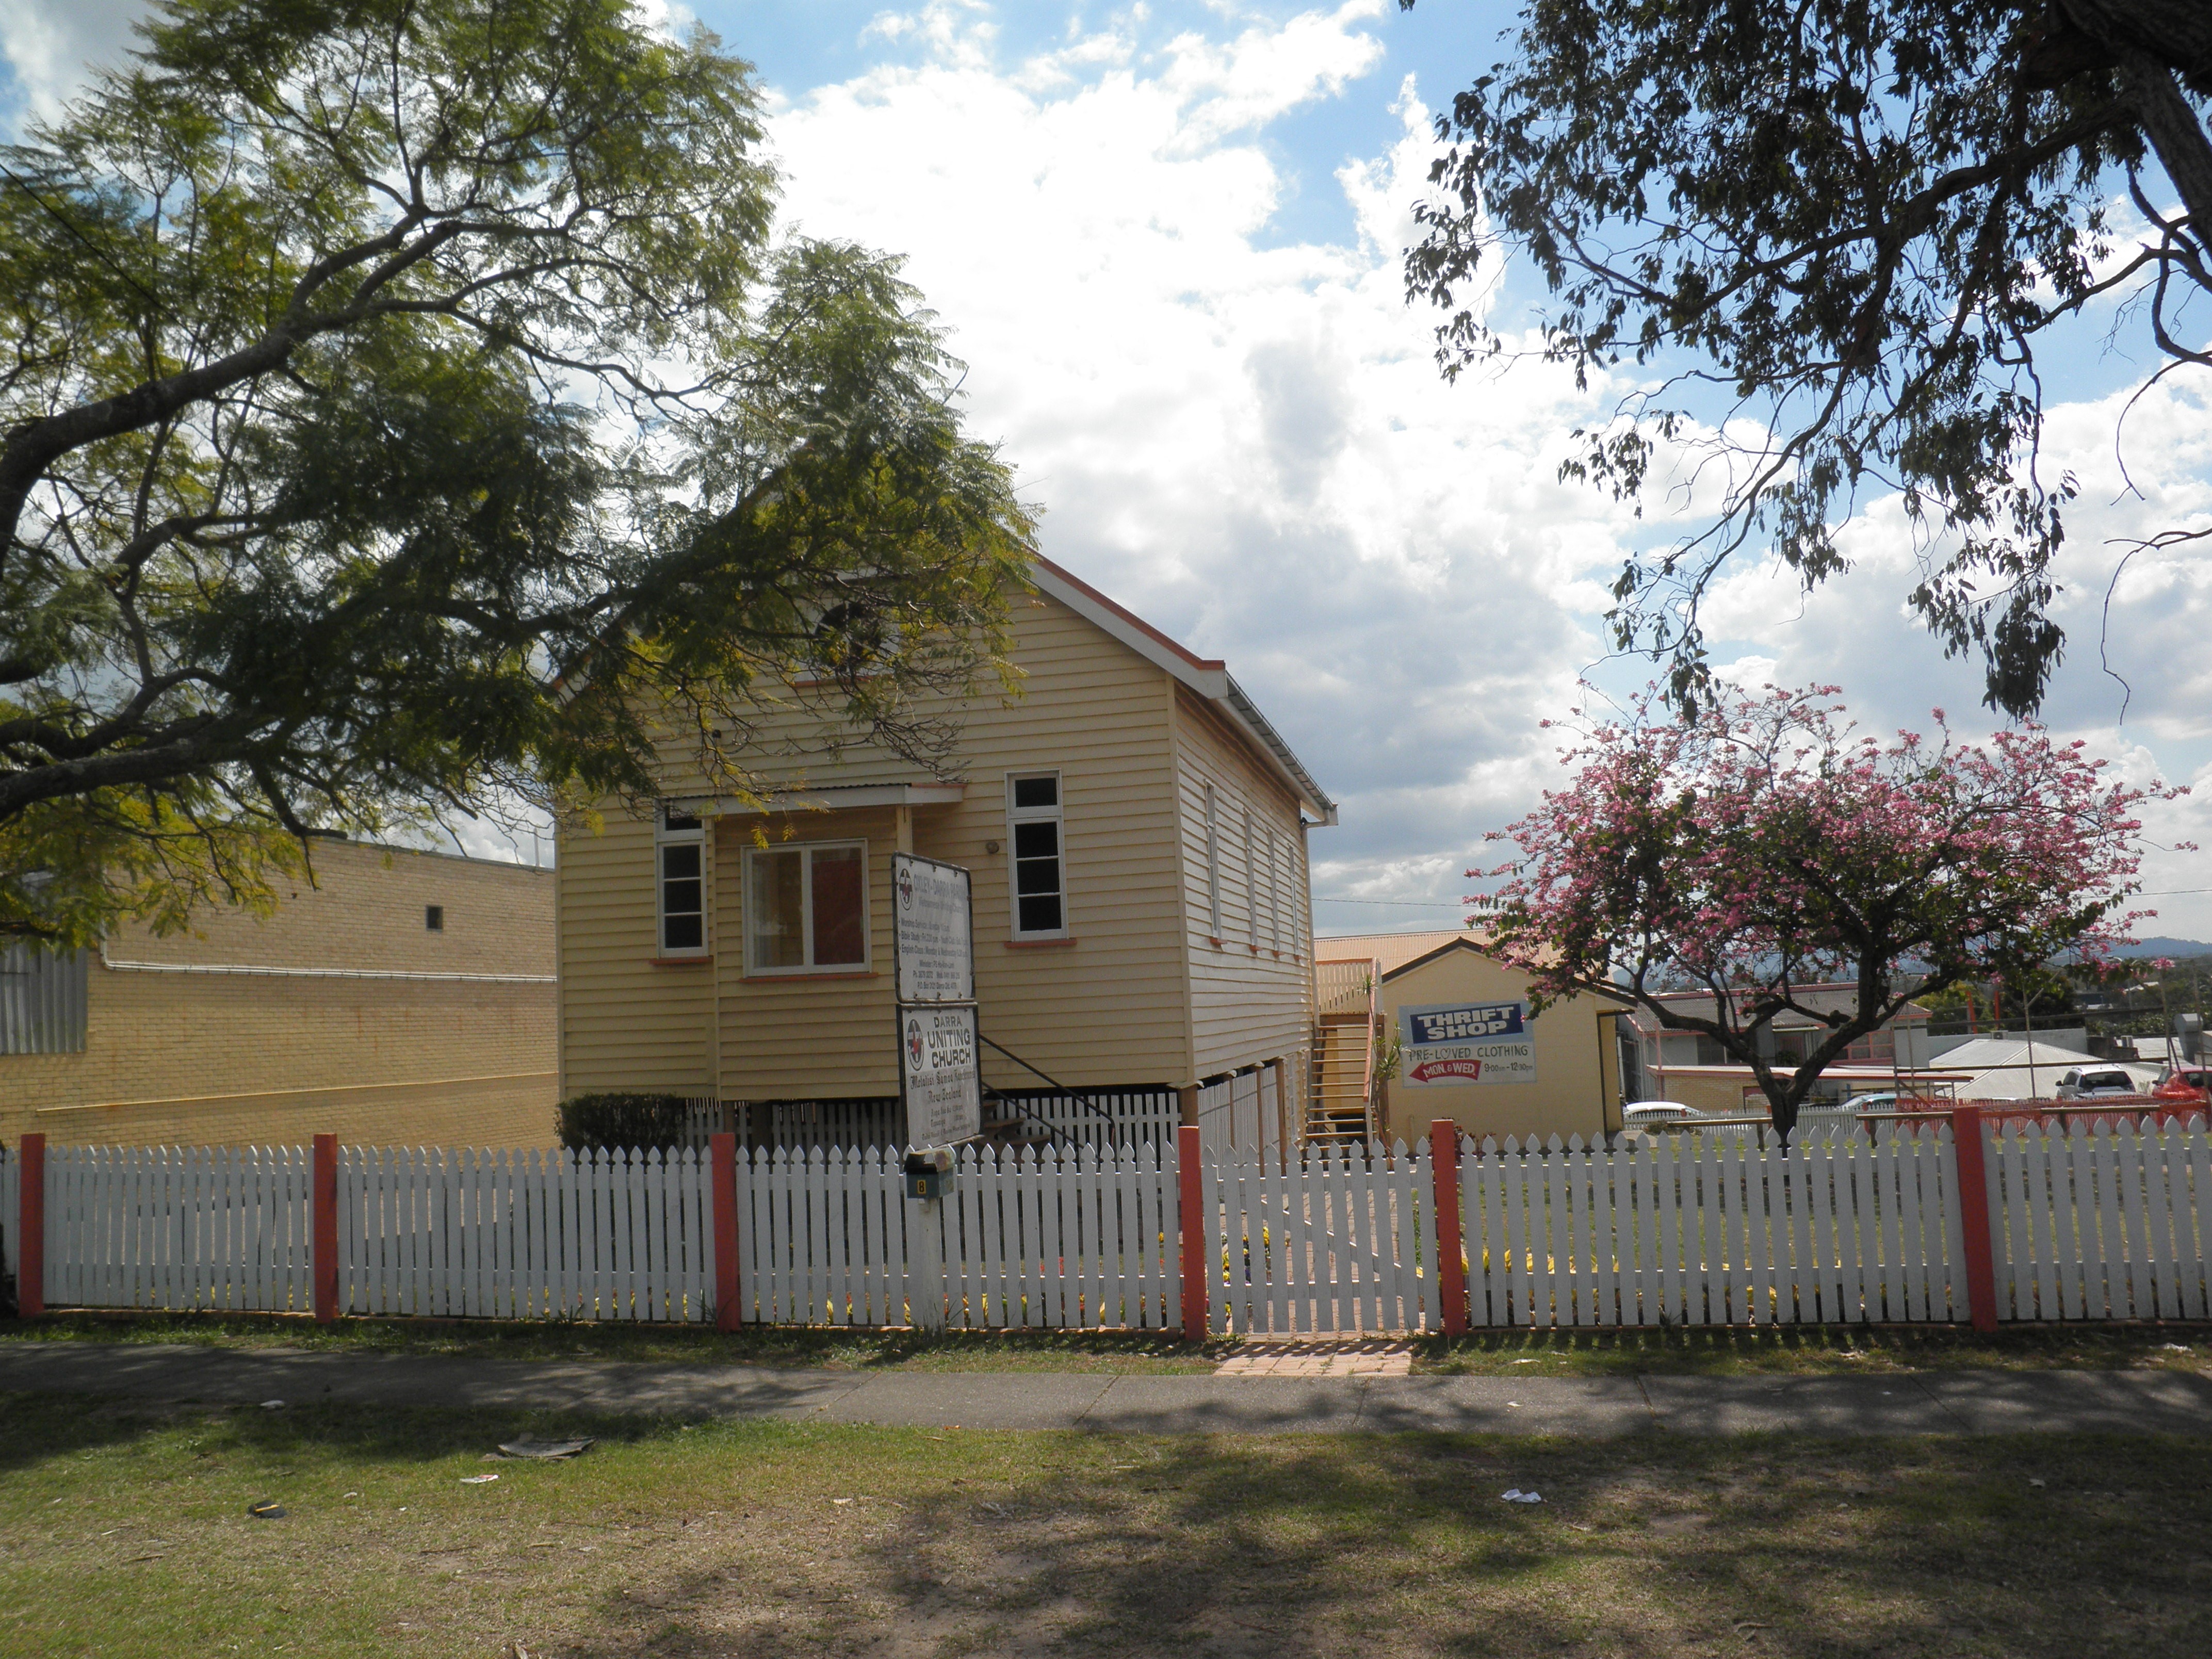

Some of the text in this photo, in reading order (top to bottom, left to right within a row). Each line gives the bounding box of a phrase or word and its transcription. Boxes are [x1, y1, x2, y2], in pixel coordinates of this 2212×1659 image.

[901, 931, 910, 940] Bible
[911, 932, 920, 943] Study
[902, 944, 914, 955] English
[915, 945, 923, 954] Class
[925, 946, 937, 957] Monday
[934, 1016, 962, 1028] DARRA
[1418, 1006, 1514, 1028] THRIFT
[1427, 1020, 1507, 1040] SHOP
[928, 1028, 970, 1049] UNITING
[932, 1048, 971, 1069] CHURCH
[1477, 1046, 1528, 1058] CLOTHING
[919, 1181, 925, 1192] 8
